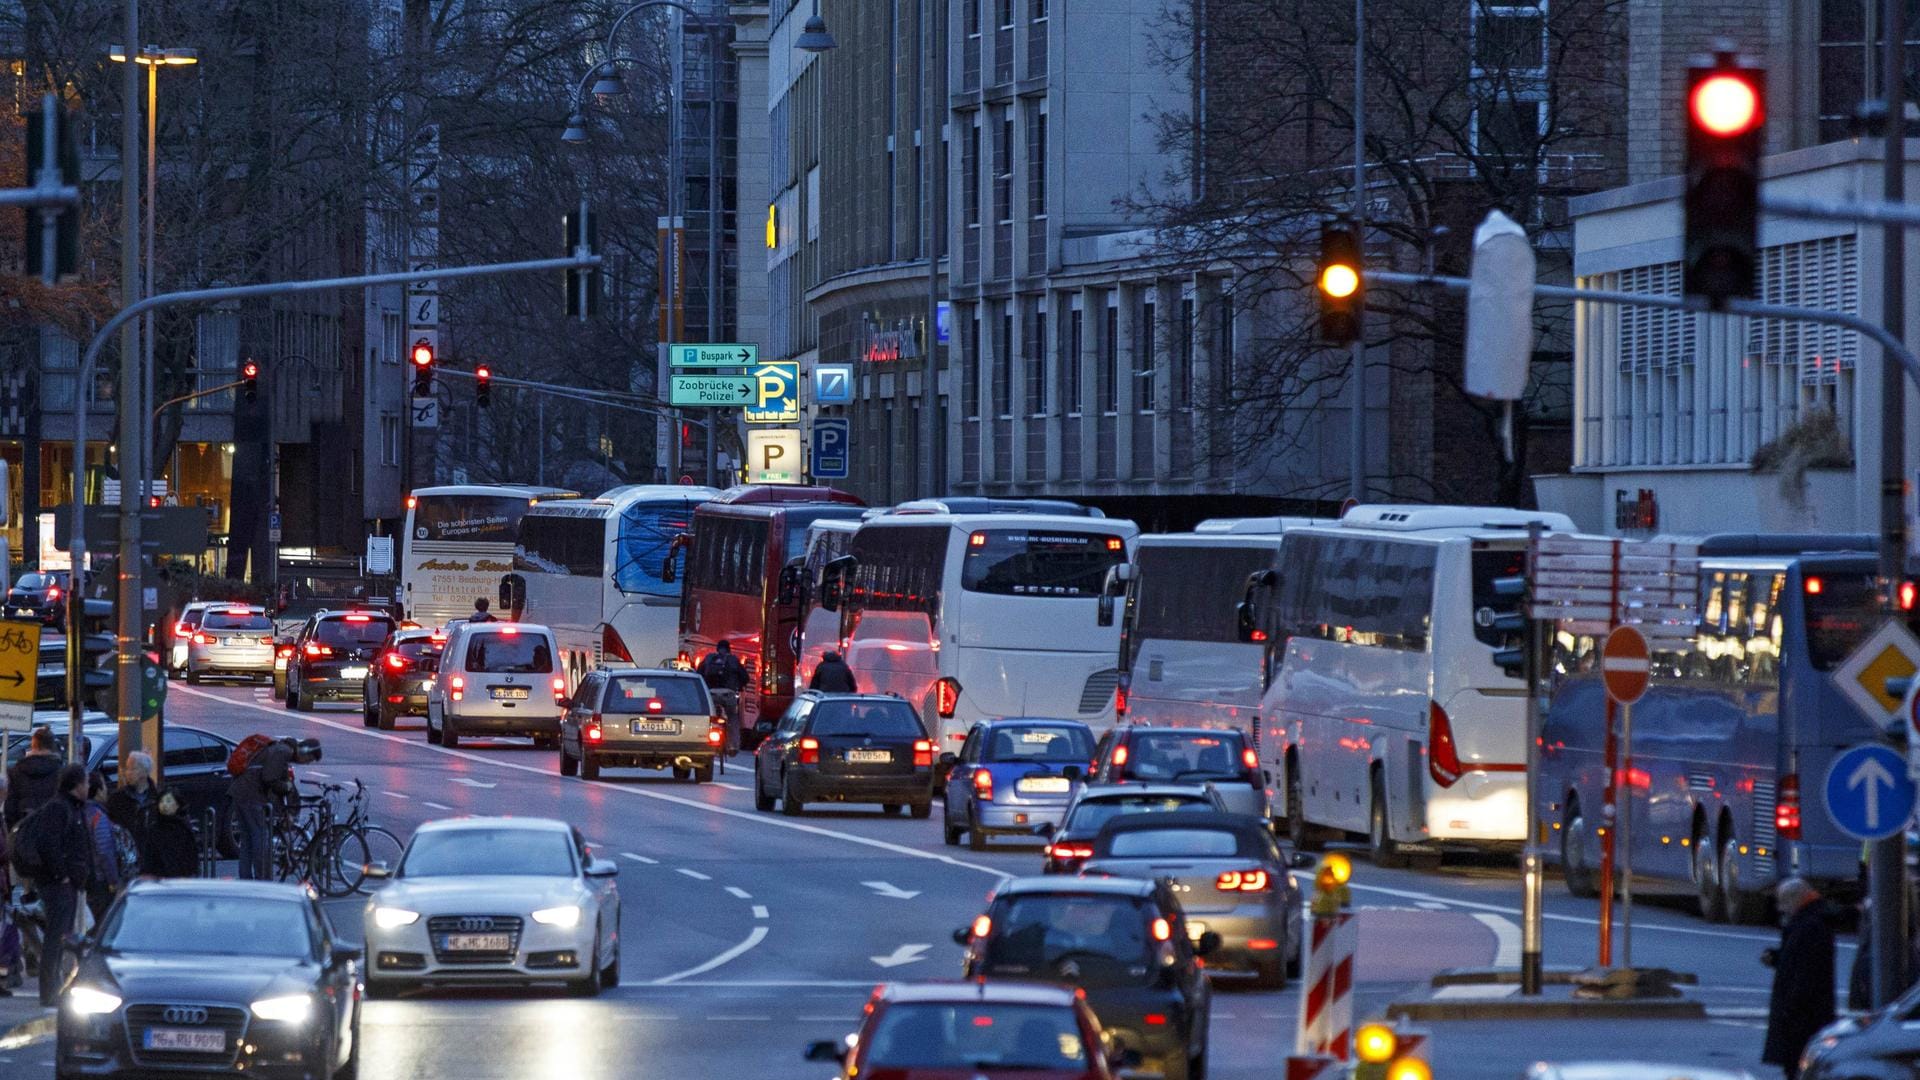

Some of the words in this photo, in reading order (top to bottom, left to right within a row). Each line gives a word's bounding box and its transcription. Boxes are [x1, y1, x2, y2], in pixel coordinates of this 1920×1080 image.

[686, 350, 695, 360] P
[701, 351, 734, 362] Buspark
[679, 380, 734, 390] Zoobrücke
[700, 391, 734, 401] Polizei
[759, 376, 786, 408] P
[821, 430, 839, 452] P
[764, 444, 785, 470] P
[437, 521, 449, 529] Die
[450, 518, 485, 528] schönsten
[486, 516, 508, 524] Seiten
[441, 528, 470, 536] Europas
[458, 575, 501, 585] Bedburg-H
